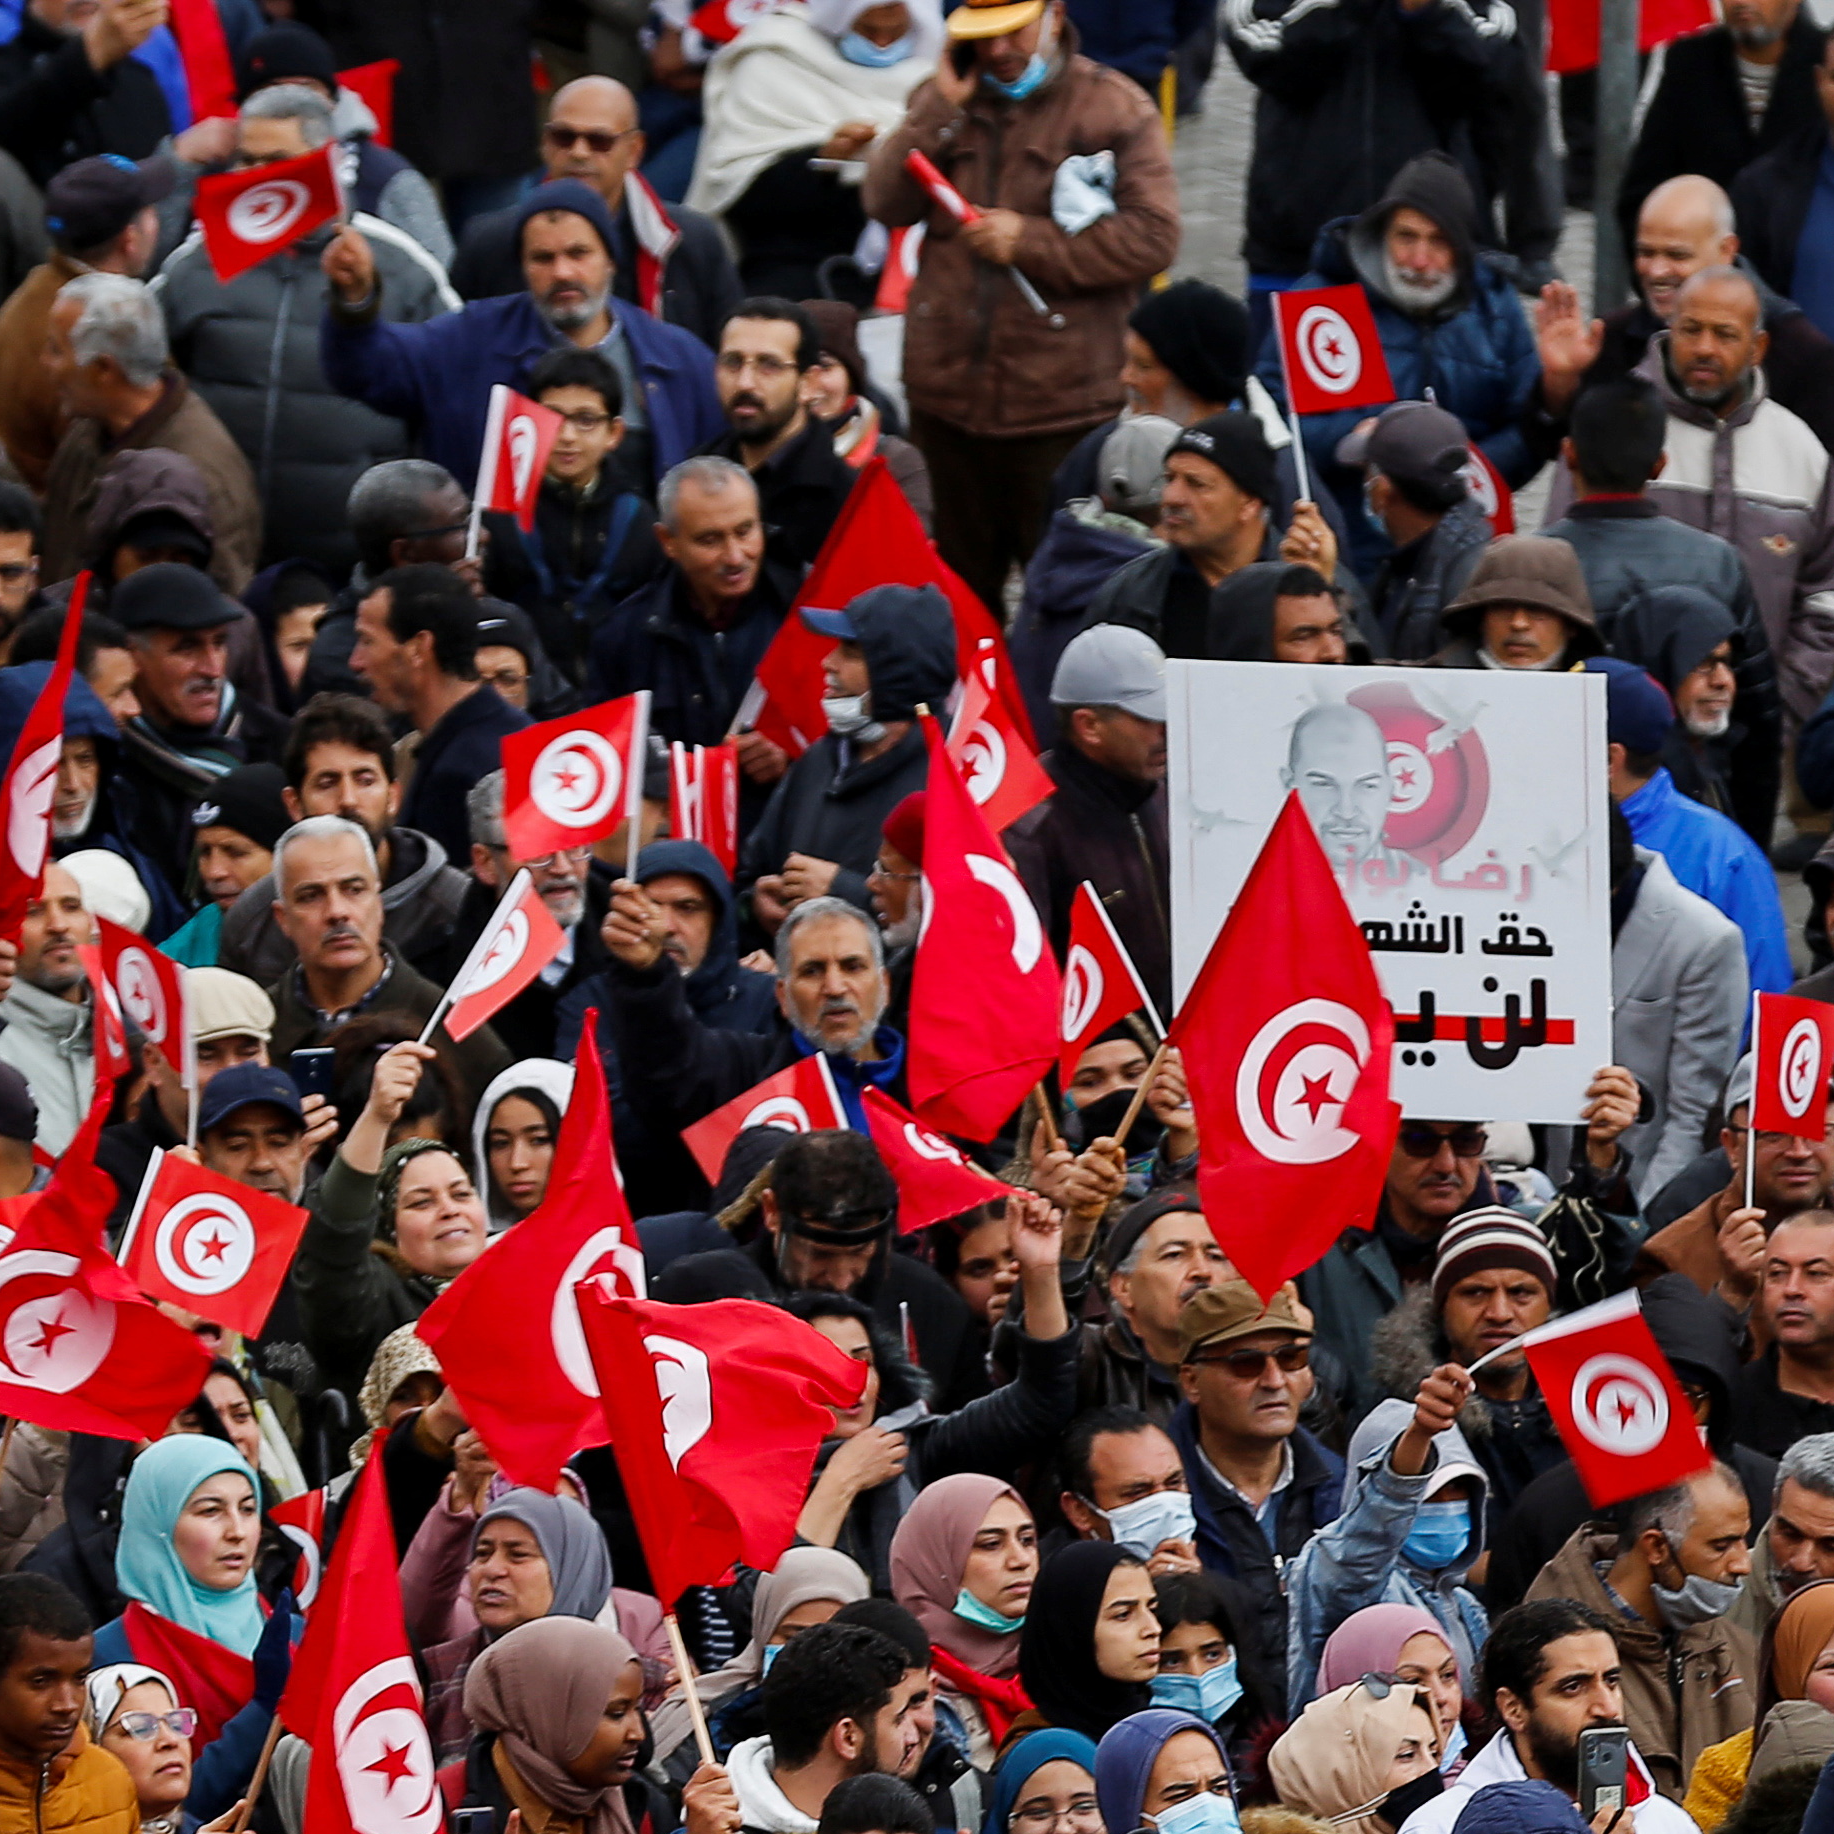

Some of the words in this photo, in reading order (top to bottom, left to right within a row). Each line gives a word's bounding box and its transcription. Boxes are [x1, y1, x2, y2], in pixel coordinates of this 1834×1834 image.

[1430, 849, 1533, 902] رضا
[1360, 900, 1464, 955] الشه
[1481, 912, 1553, 957] حق
[1466, 977, 1547, 1071] لن
